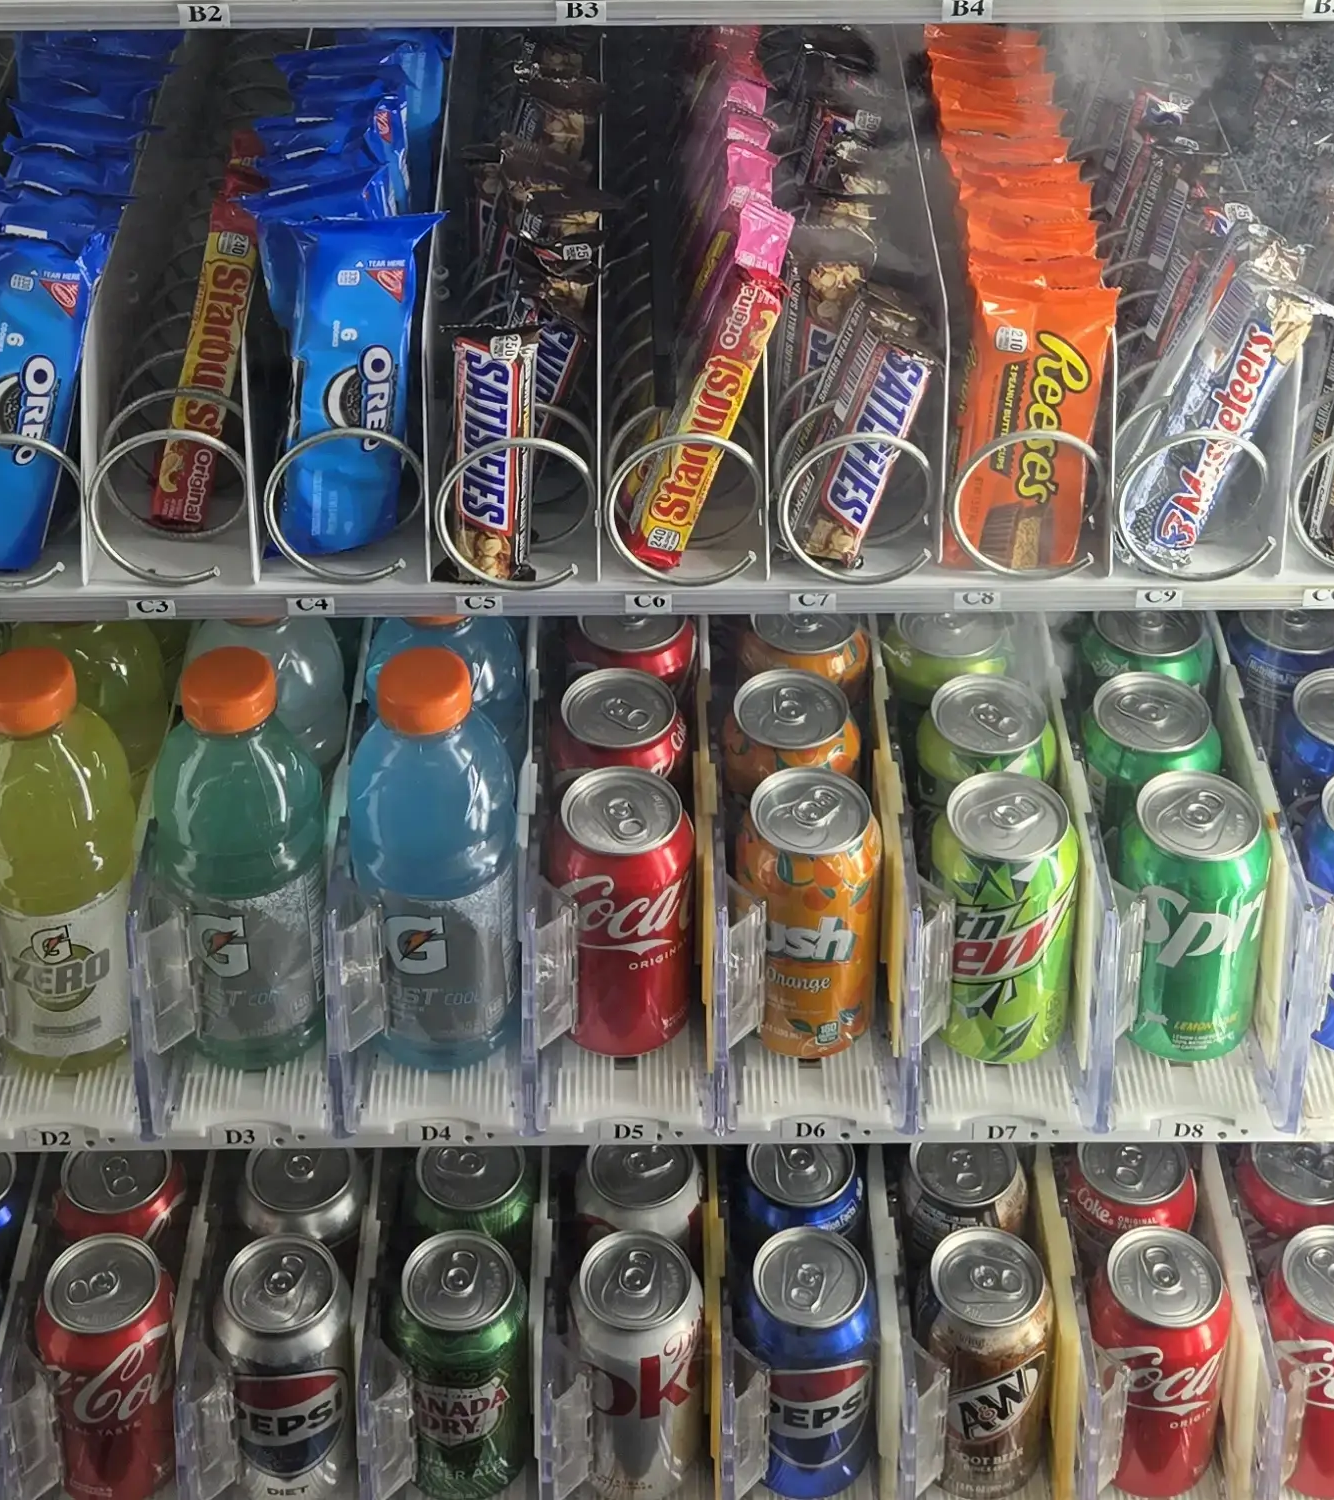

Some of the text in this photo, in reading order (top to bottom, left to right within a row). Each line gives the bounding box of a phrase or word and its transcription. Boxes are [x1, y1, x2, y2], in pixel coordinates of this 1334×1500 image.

[188, 5, 223, 22] B2
[566, 0, 599, 19] B3
[951, 0, 985, 17] B4
[233, 234, 247, 256] 240
[5, 332, 25, 347] 6
[340, 327, 358, 341] 6
[185, 263, 253, 441] Starbust
[505, 335, 519, 357] 250
[817, 328, 854, 402] SNICKERS REALLY
[362, 346, 393, 452] OREO
[1003, 371, 1018, 409] PEANUT
[15, 356, 56, 466] OREO
[1016, 332, 1091, 503] Reese's
[461, 351, 510, 525] SATISFIES
[650, 355, 743, 523] Starurst
[185, 447, 213, 524] Original
[1159, 507, 1197, 547] 3
[295, 597, 329, 613] C4
[463, 596, 497, 610] C5
[632, 593, 666, 609] C6
[797, 592, 831, 607] C7
[962, 591, 995, 606] C8
[1144, 588, 1178, 604] C9
[135, 599, 170, 615] C3
[30, 924, 73, 966] G
[192, 912, 251, 979] G
[384, 914, 449, 976] G
[11, 948, 111, 995] ZERO
[41, 1131, 71, 1147] D2
[224, 1129, 256, 1145] D3
[420, 1125, 452, 1141] D4
[613, 1124, 645, 1140] D5
[795, 1122, 826, 1138] D6
[986, 1124, 1018, 1140] D7
[1174, 1122, 1204, 1137] D8
[1076, 1187, 1158, 1227] Coke ORIGINAL
[413, 1387, 508, 1419] ANADA
[958, 1367, 1038, 1438] A&W
[266, 1484, 310, 1498] DIET
